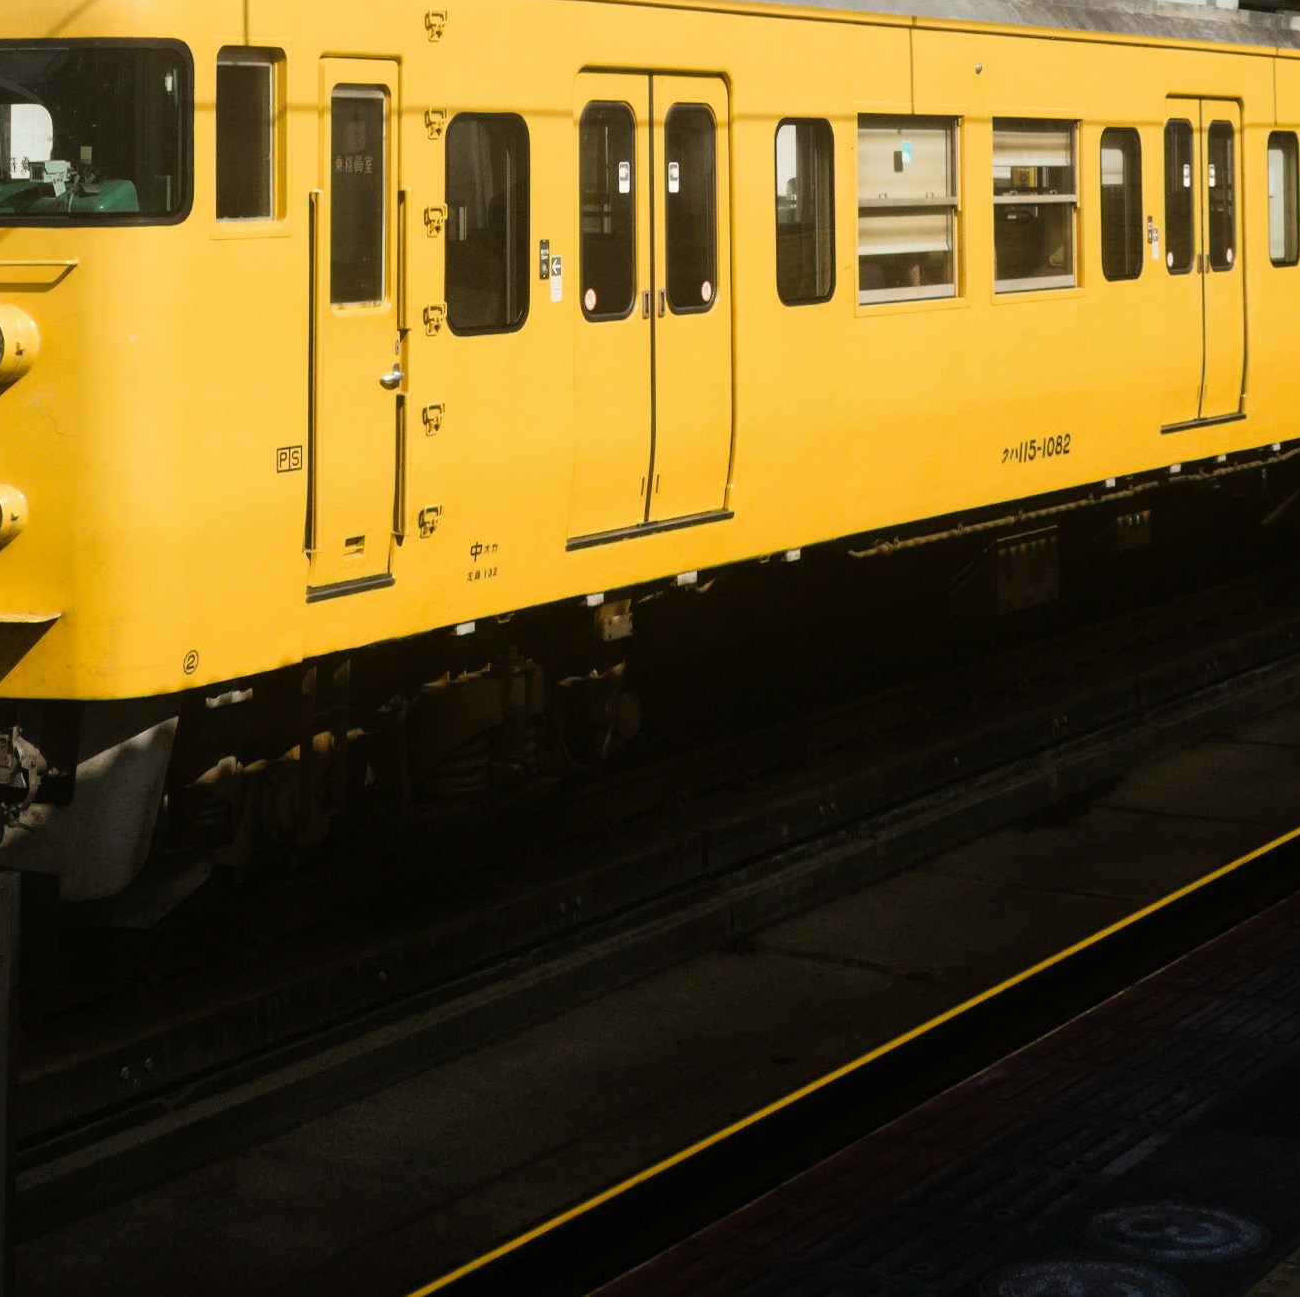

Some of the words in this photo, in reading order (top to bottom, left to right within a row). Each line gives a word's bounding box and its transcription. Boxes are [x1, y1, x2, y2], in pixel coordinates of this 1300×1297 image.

[334, 155, 373, 174] 乗務員室
[1001, 433, 1071, 464] クハ115-1082
